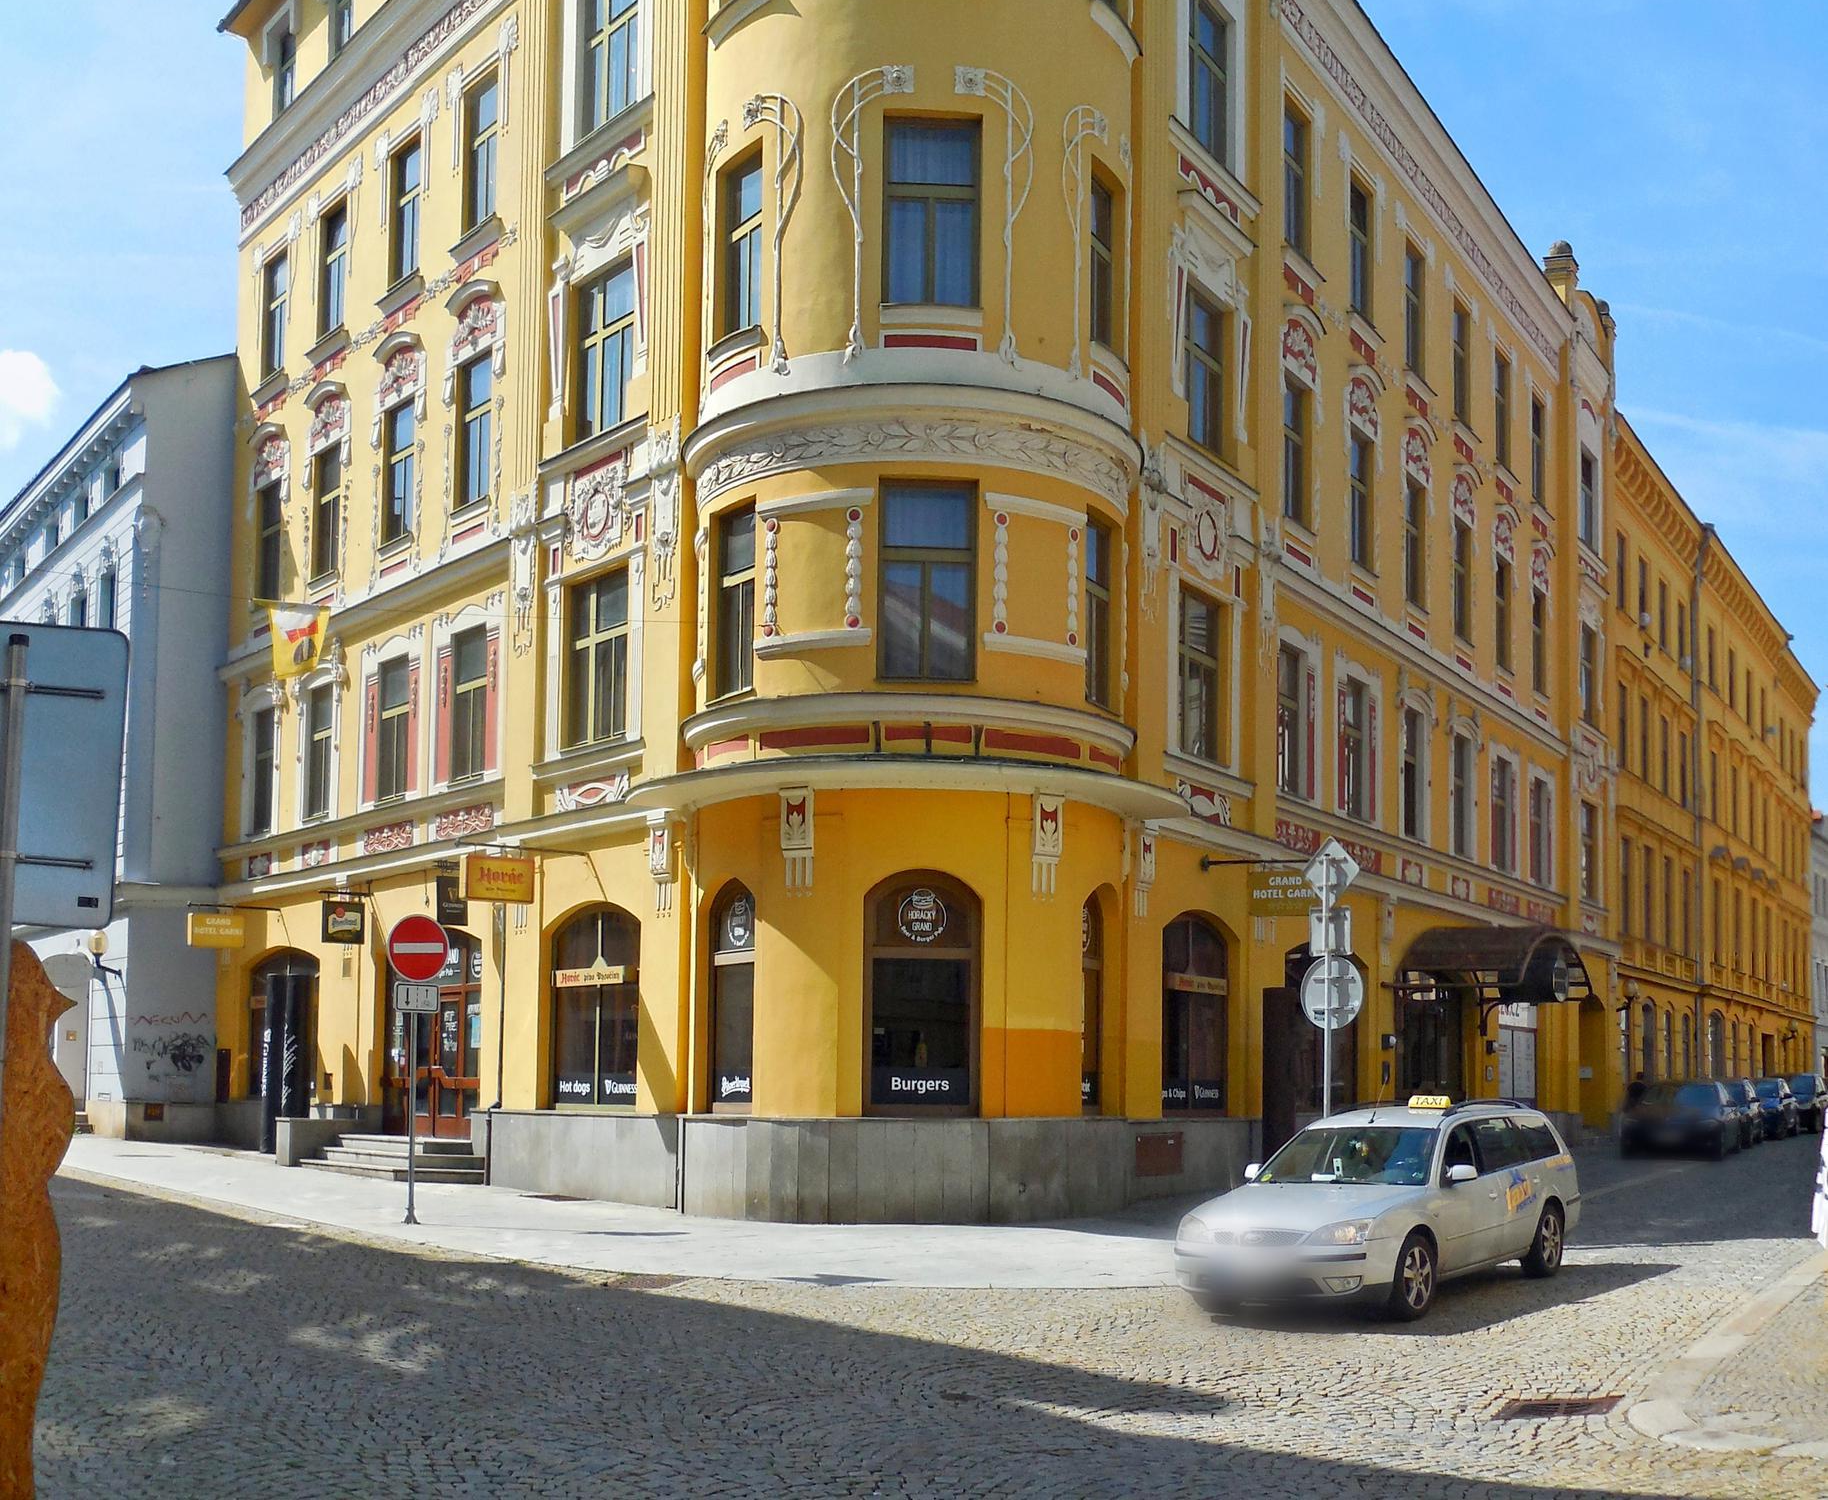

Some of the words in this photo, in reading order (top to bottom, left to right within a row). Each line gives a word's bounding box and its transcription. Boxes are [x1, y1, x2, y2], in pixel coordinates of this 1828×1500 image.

[1268, 876, 1303, 886] GRAND
[1253, 889, 1285, 899] HOTEL
[911, 921, 933, 931] GRAND
[559, 1080, 573, 1093] Hot
[573, 1080, 591, 1096] dogs
[891, 1076, 950, 1094] Burgers
[1415, 1097, 1443, 1106] TAXI
